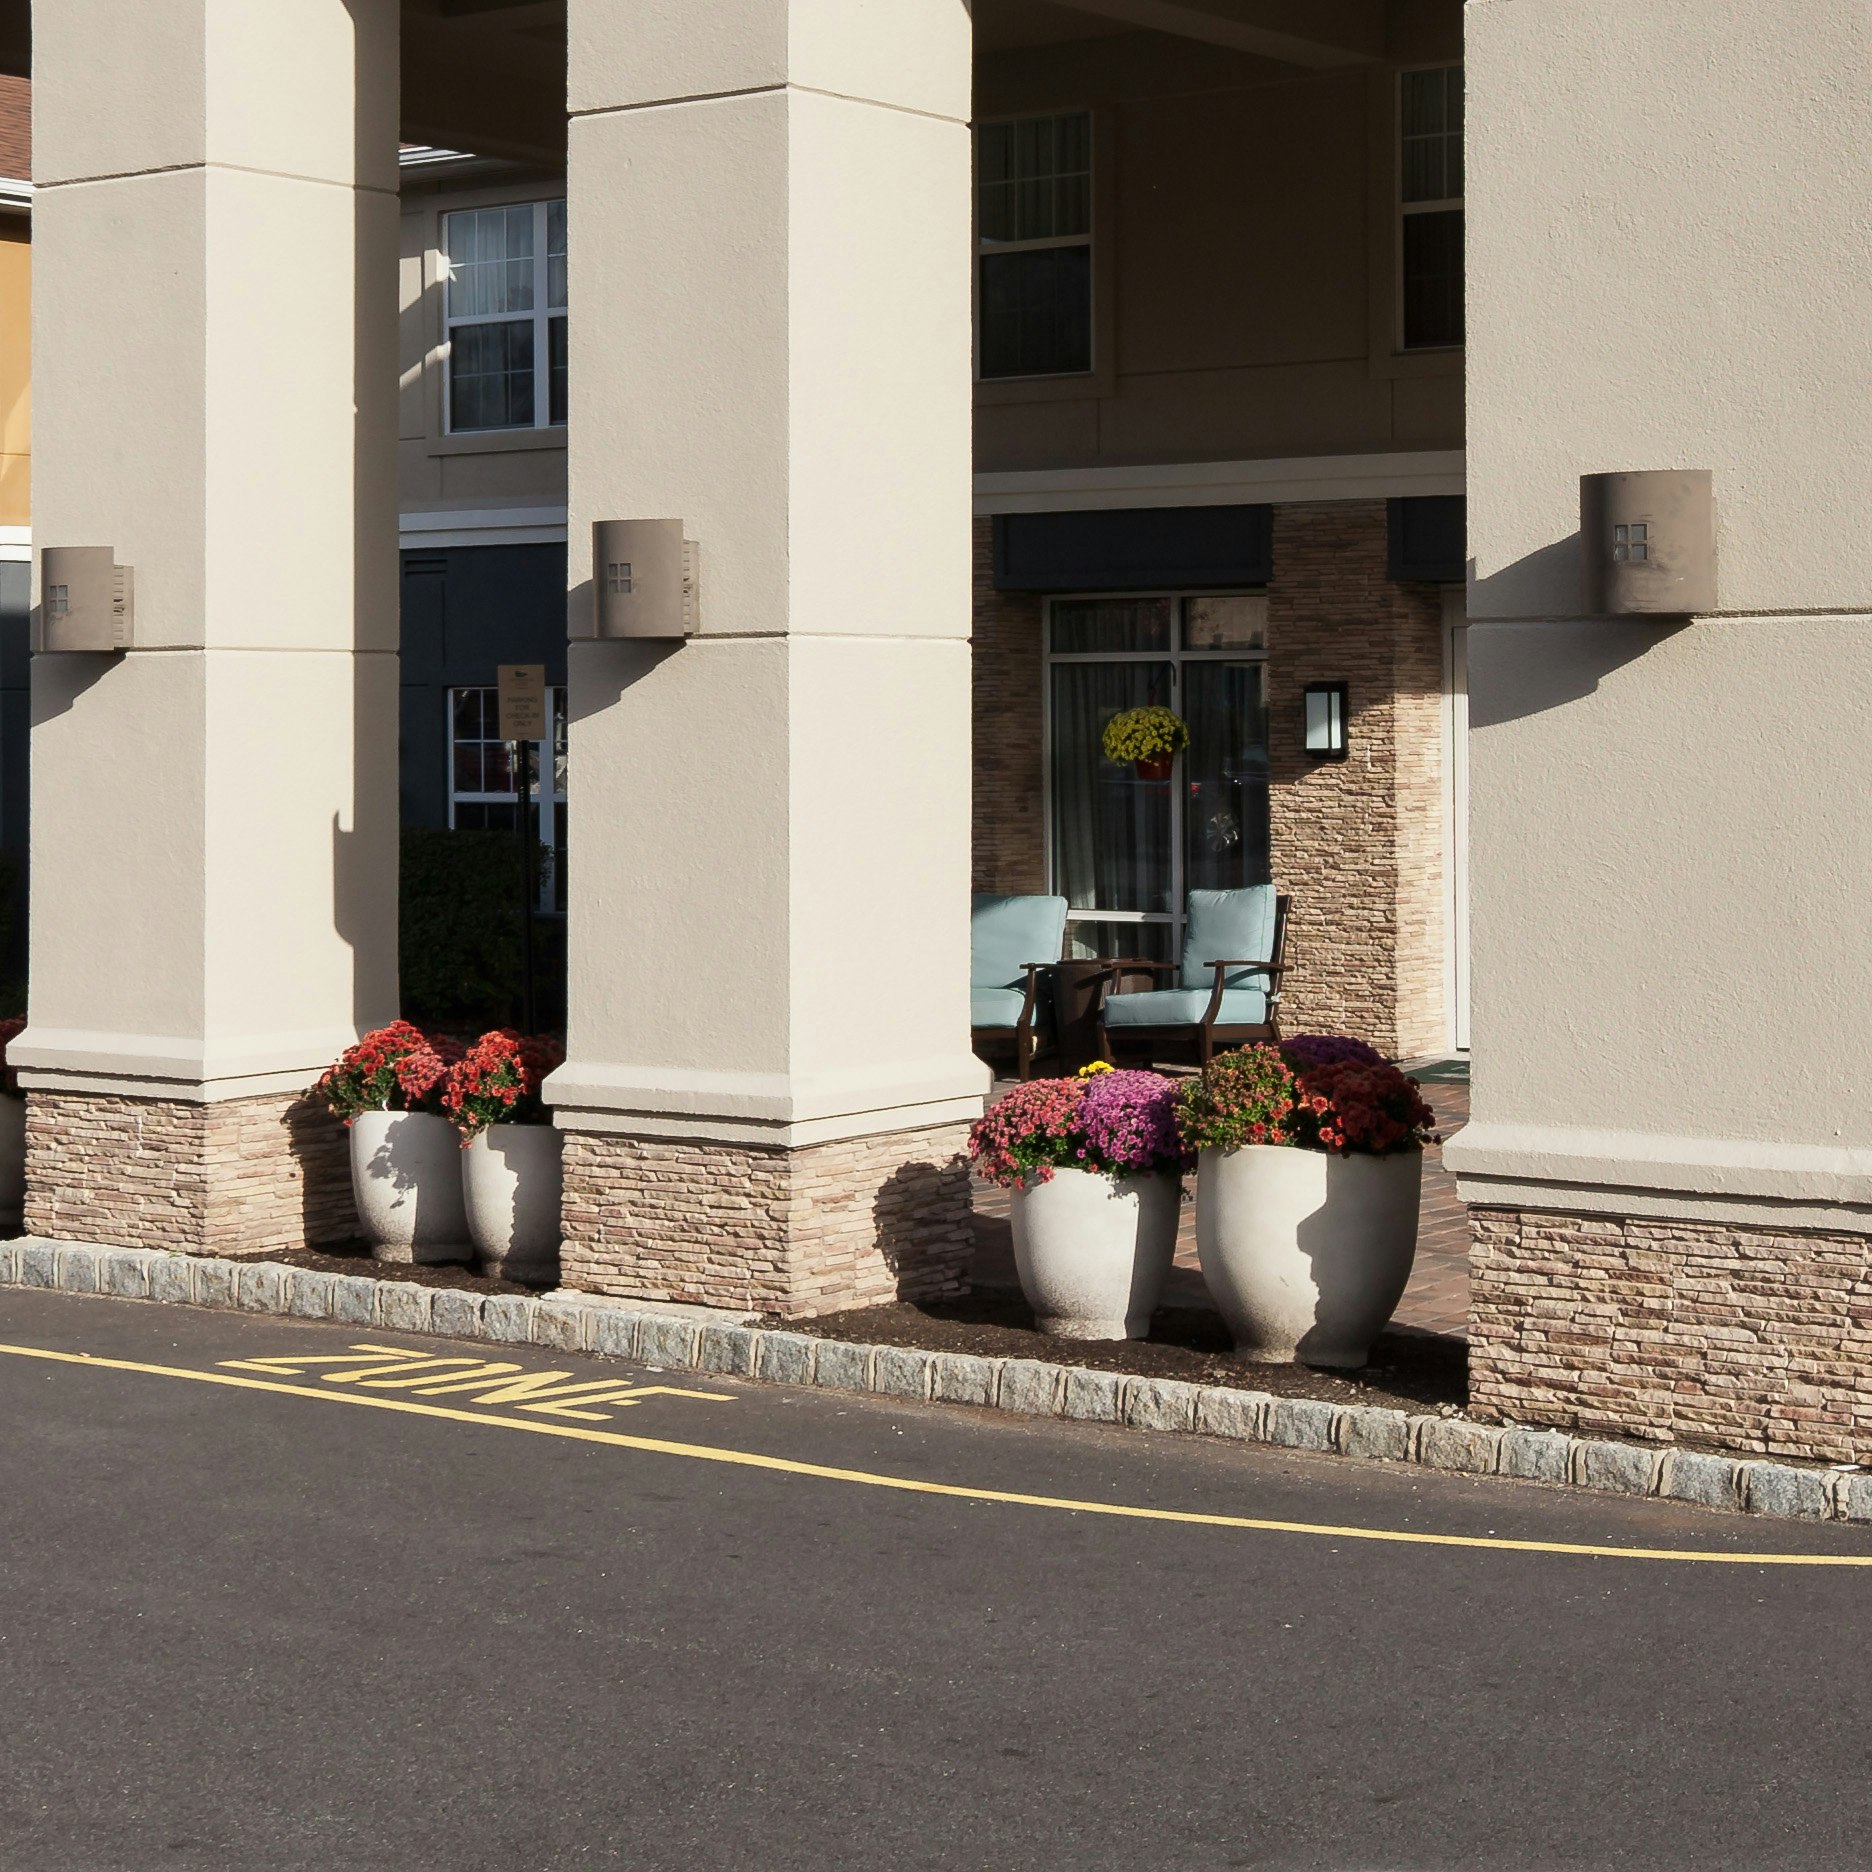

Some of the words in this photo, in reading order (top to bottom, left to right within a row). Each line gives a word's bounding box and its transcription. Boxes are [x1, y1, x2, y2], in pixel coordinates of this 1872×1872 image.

[514, 704, 530, 712] FOR
[512, 720, 533, 728] ONLY
[214, 1343, 740, 1421] ZONE
